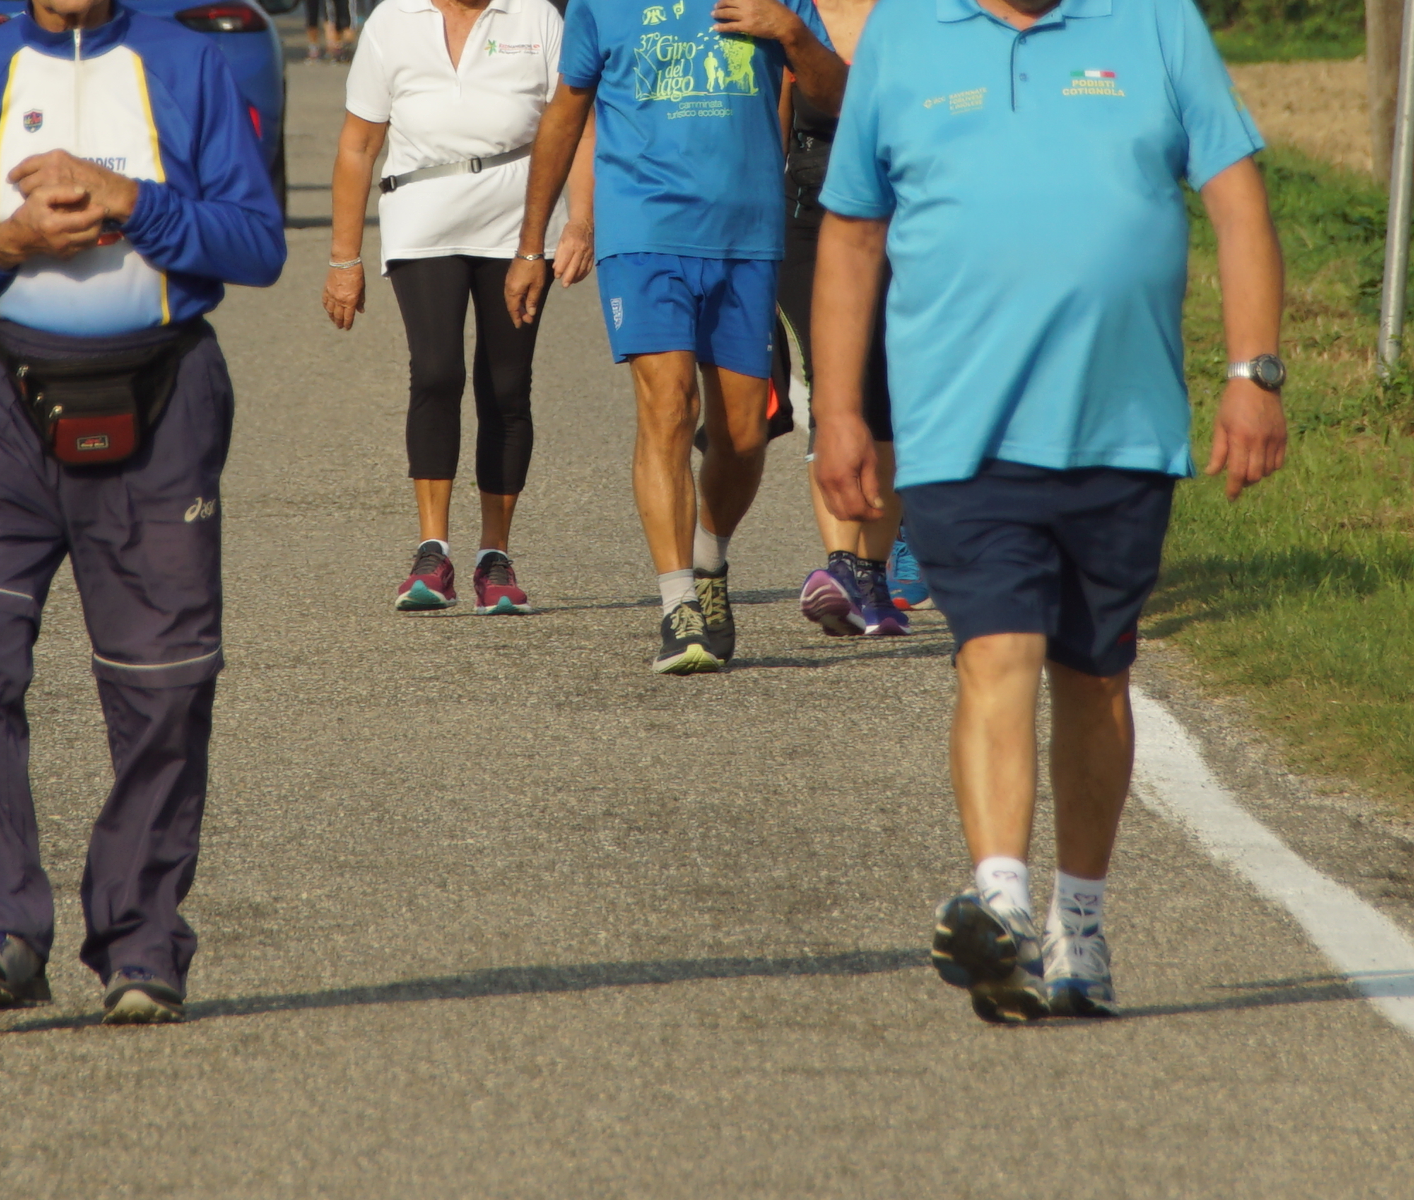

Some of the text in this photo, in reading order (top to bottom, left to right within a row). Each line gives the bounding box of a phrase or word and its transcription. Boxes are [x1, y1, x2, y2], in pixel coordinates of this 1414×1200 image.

[656, 35, 697, 61] Giro
[665, 58, 685, 78] del
[656, 70, 694, 102] lago
[1071, 79, 1115, 88] PODISTI
[1062, 87, 1126, 97] COTIGNOLA
[678, 99, 723, 110] camminata
[698, 107, 733, 118] ecologic
